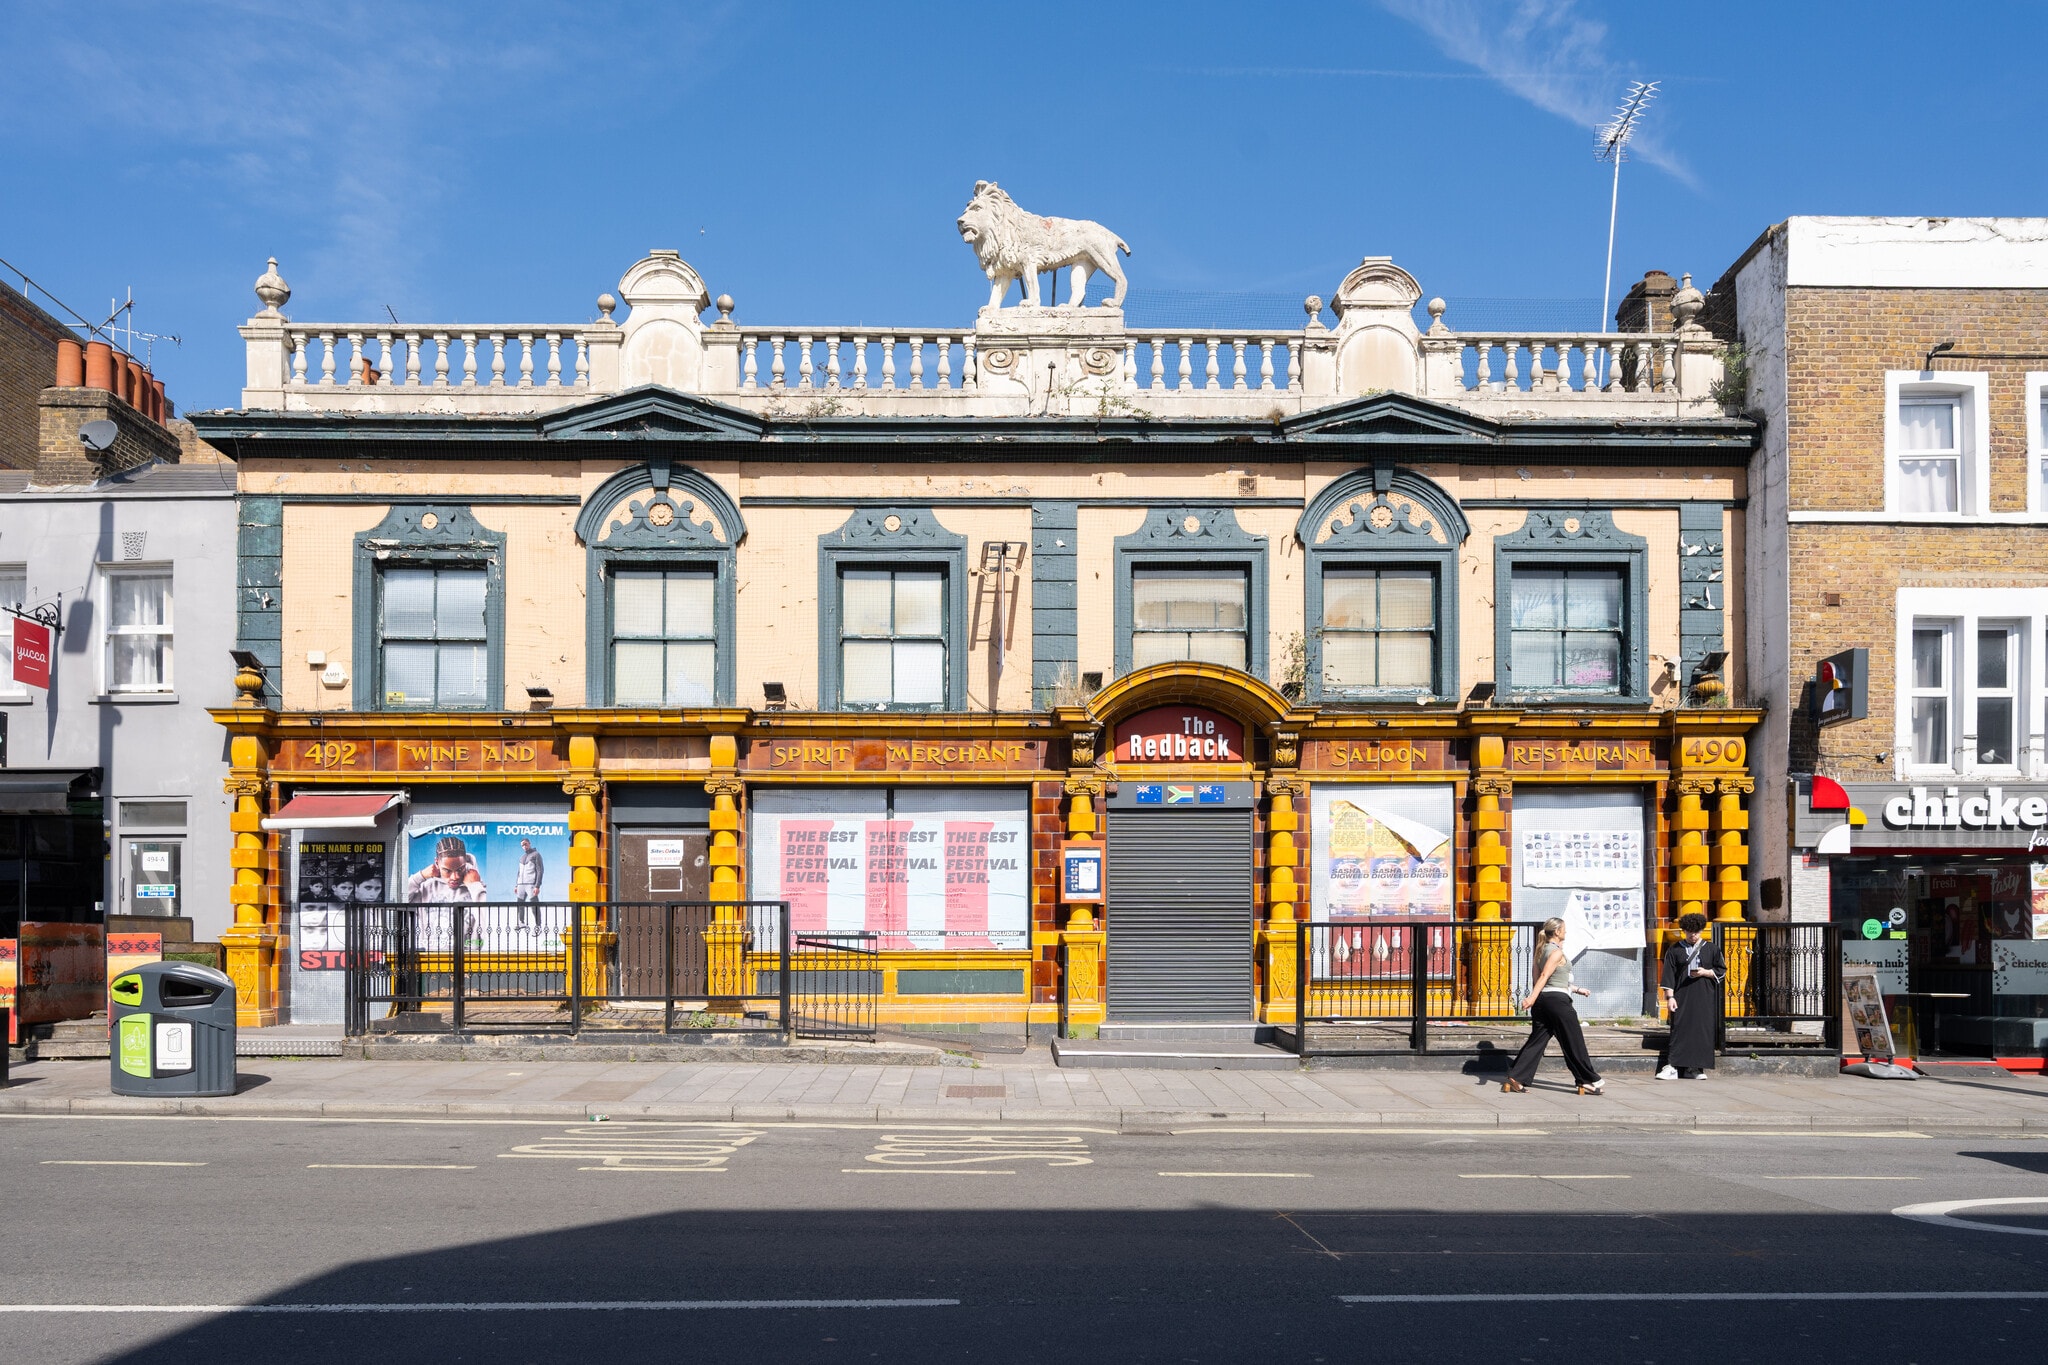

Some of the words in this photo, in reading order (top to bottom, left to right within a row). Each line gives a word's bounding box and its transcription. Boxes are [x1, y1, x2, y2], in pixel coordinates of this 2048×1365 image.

[17, 646, 46, 663] yucca
[1183, 716, 1214, 735] The
[1130, 734, 1229, 757] Redback
[1686, 740, 1742, 763] 490
[304, 743, 356, 768] 492
[403, 745, 469, 762] WINE
[483, 744, 535, 763] AND
[770, 746, 851, 767] SPIRIT
[886, 744, 1026, 765] MERCHANT
[1331, 747, 1427, 766] SALOON
[1513, 746, 1652, 764] RESTAURANT
[1885, 786, 2048, 826] chicke
[787, 831, 817, 842] THE
[819, 831, 859, 843] BEST
[869, 831, 896, 842] THE
[899, 831, 938, 843] BEST
[947, 831, 977, 843] THE
[979, 831, 1018, 843] BEST
[300, 844, 309, 853] IN
[312, 844, 326, 853] THE
[328, 844, 351, 853] NAME
[354, 844, 364, 853] OF
[366, 844, 383, 853] GOD
[786, 845, 826, 856] BEER
[869, 845, 905, 856] BEER
[946, 845, 985, 857] BEER
[786, 858, 859, 870] FESTIVAL
[869, 858, 938, 870] FESTIVAL
[946, 858, 1018, 870] FESTIVAL
[786, 872, 830, 883] EVER.
[869, 872, 910, 883] EVER.
[946, 872, 990, 884] EVER.
[1932, 877, 1957, 889] fresh
[1992, 872, 2022, 896] tasty
[1885, 958, 1904, 968] hub
